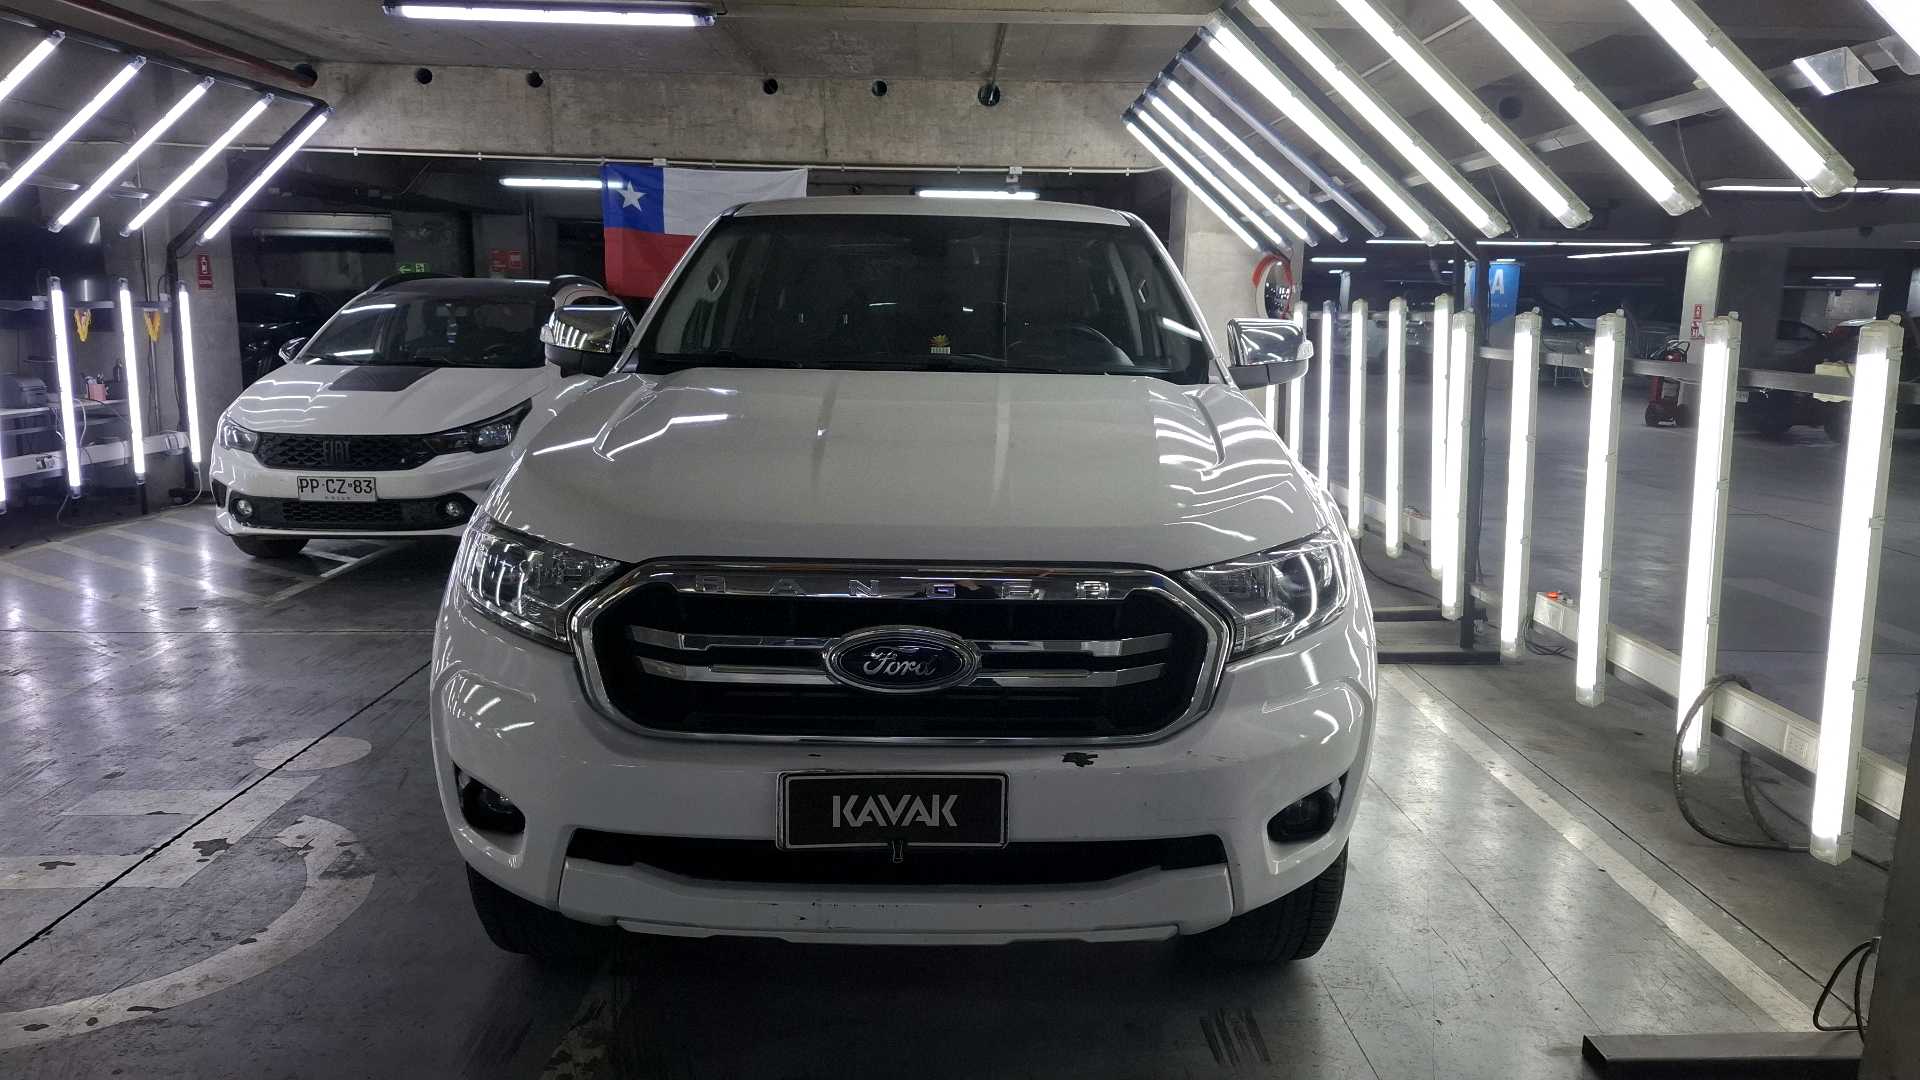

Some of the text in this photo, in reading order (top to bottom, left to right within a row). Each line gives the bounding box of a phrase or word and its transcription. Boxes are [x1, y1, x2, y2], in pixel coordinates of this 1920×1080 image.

[322, 439, 352, 463] FIAT
[695, 575, 1109, 600] RANGER
[863, 646, 938, 676] Ford
[831, 794, 960, 828] KAVAK
